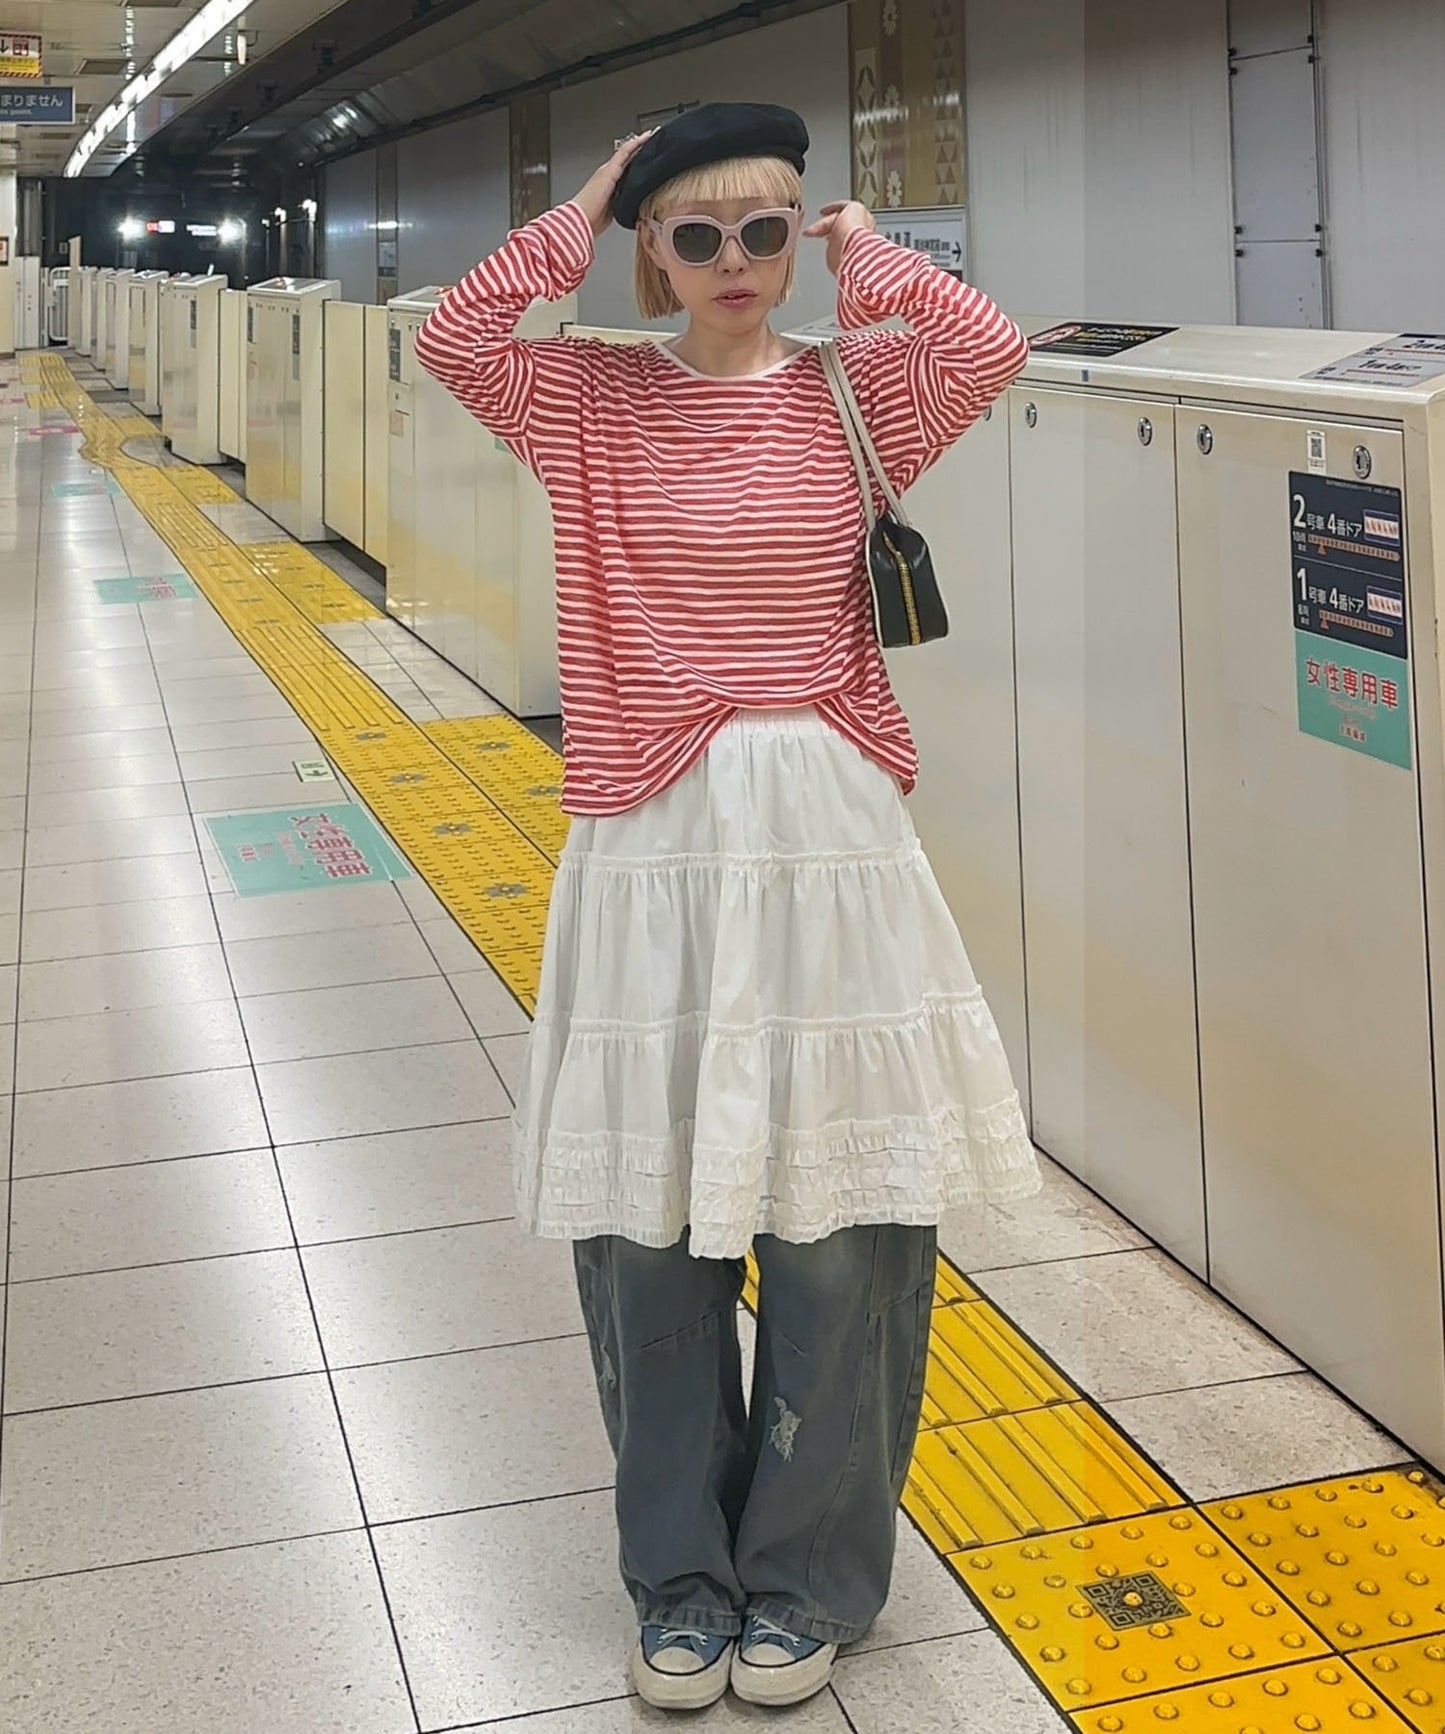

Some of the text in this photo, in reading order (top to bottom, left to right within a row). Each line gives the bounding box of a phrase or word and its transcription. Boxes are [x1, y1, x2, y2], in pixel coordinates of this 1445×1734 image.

[1, 94, 63, 107] まりません
[1293, 493, 1363, 538] 2号車 4番ドア
[1296, 567, 1365, 614] 1号車 4番ドア
[1305, 658, 1399, 710] 女性専用車
